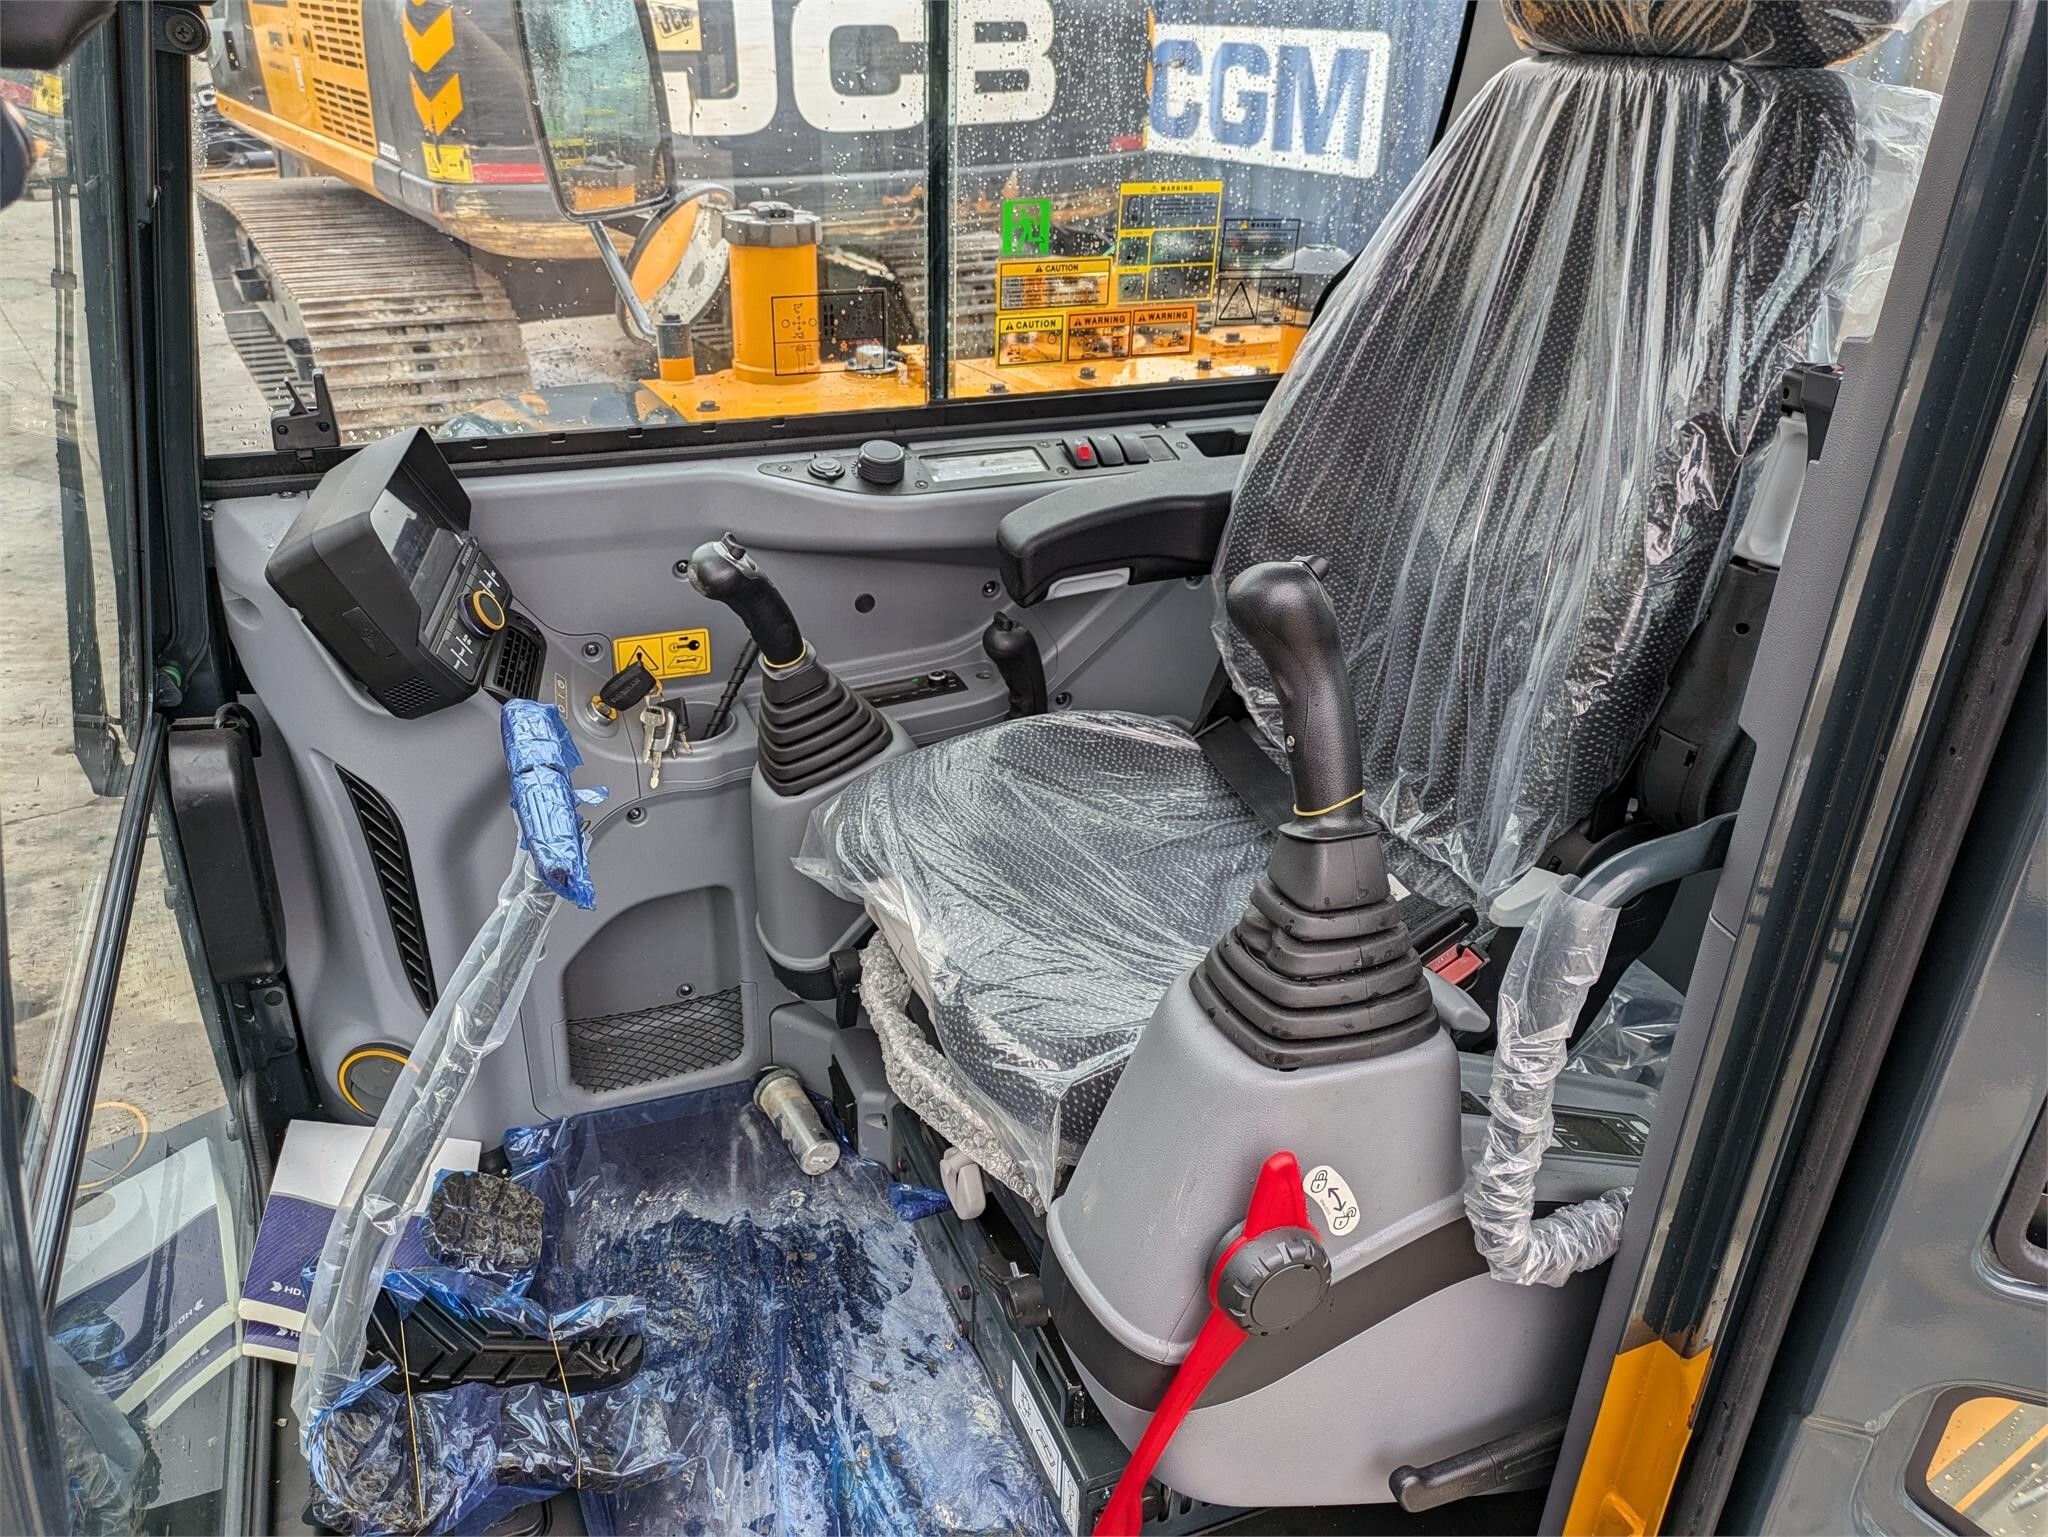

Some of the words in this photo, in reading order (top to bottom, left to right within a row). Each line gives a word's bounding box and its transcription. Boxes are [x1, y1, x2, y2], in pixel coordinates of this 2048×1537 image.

[662, 0, 1057, 137] JCB
[1149, 39, 1370, 160] CGM
[1160, 184, 1194, 192] WARNING
[1045, 263, 1079, 273] CAUTION
[1084, 315, 1125, 326] WARNING
[1147, 310, 1188, 321] WARNING
[1016, 319, 1056, 330] CAUTION
[284, 1285, 301, 1296] HD
